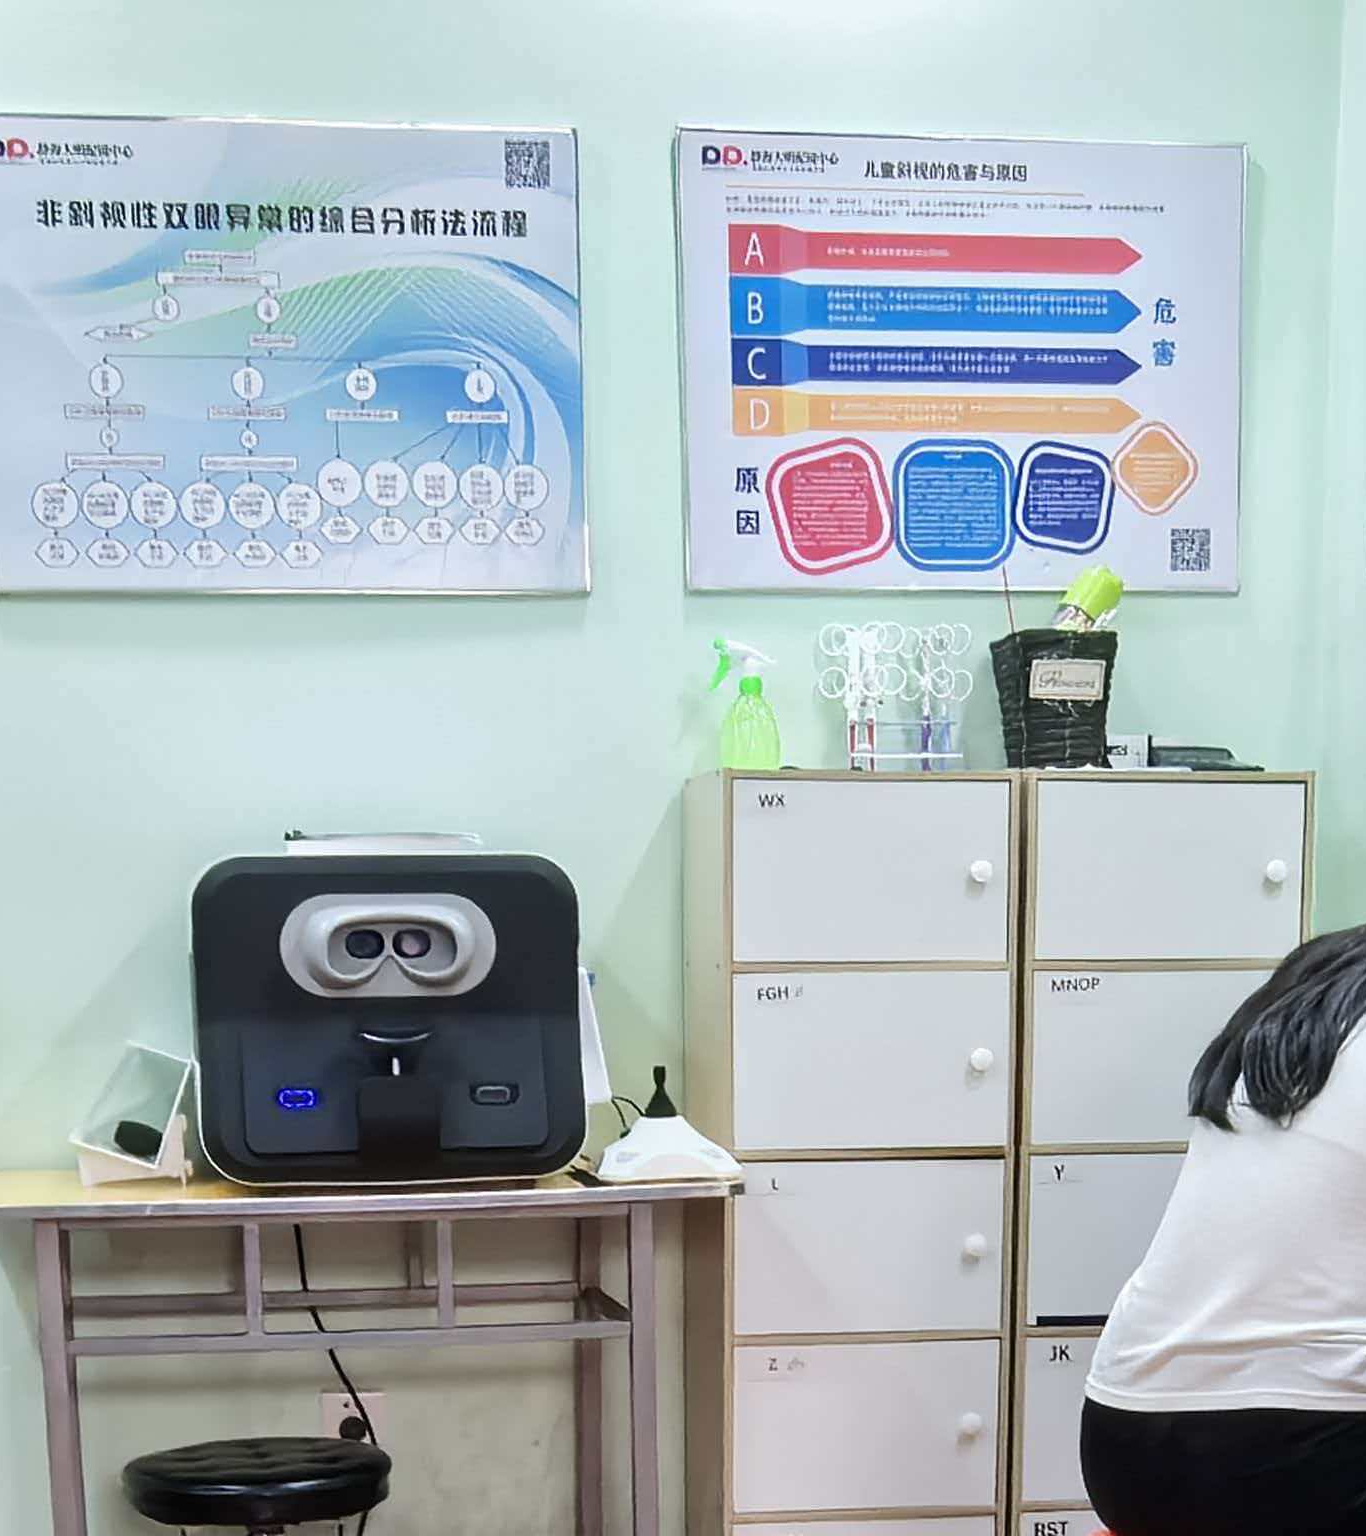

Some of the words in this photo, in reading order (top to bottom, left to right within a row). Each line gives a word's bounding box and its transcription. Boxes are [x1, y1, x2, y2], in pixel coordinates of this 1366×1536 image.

[864, 160, 1028, 182] 儿童斜视的危害与原因
[36, 199, 527, 238] 非斜视性双眼异常的综合分析法流程
[744, 232, 764, 266] A
[747, 291, 764, 324] B
[1152, 297, 1177, 367] 危害
[747, 347, 767, 380] C
[749, 398, 770, 430] D
[735, 467, 761, 535] 原因
[758, 793, 785, 808] WX
[757, 985, 790, 1001] FGH
[1051, 976, 1100, 993] MNOP
[1054, 1164, 1065, 1182] Y
[1049, 1344, 1072, 1362] JK
